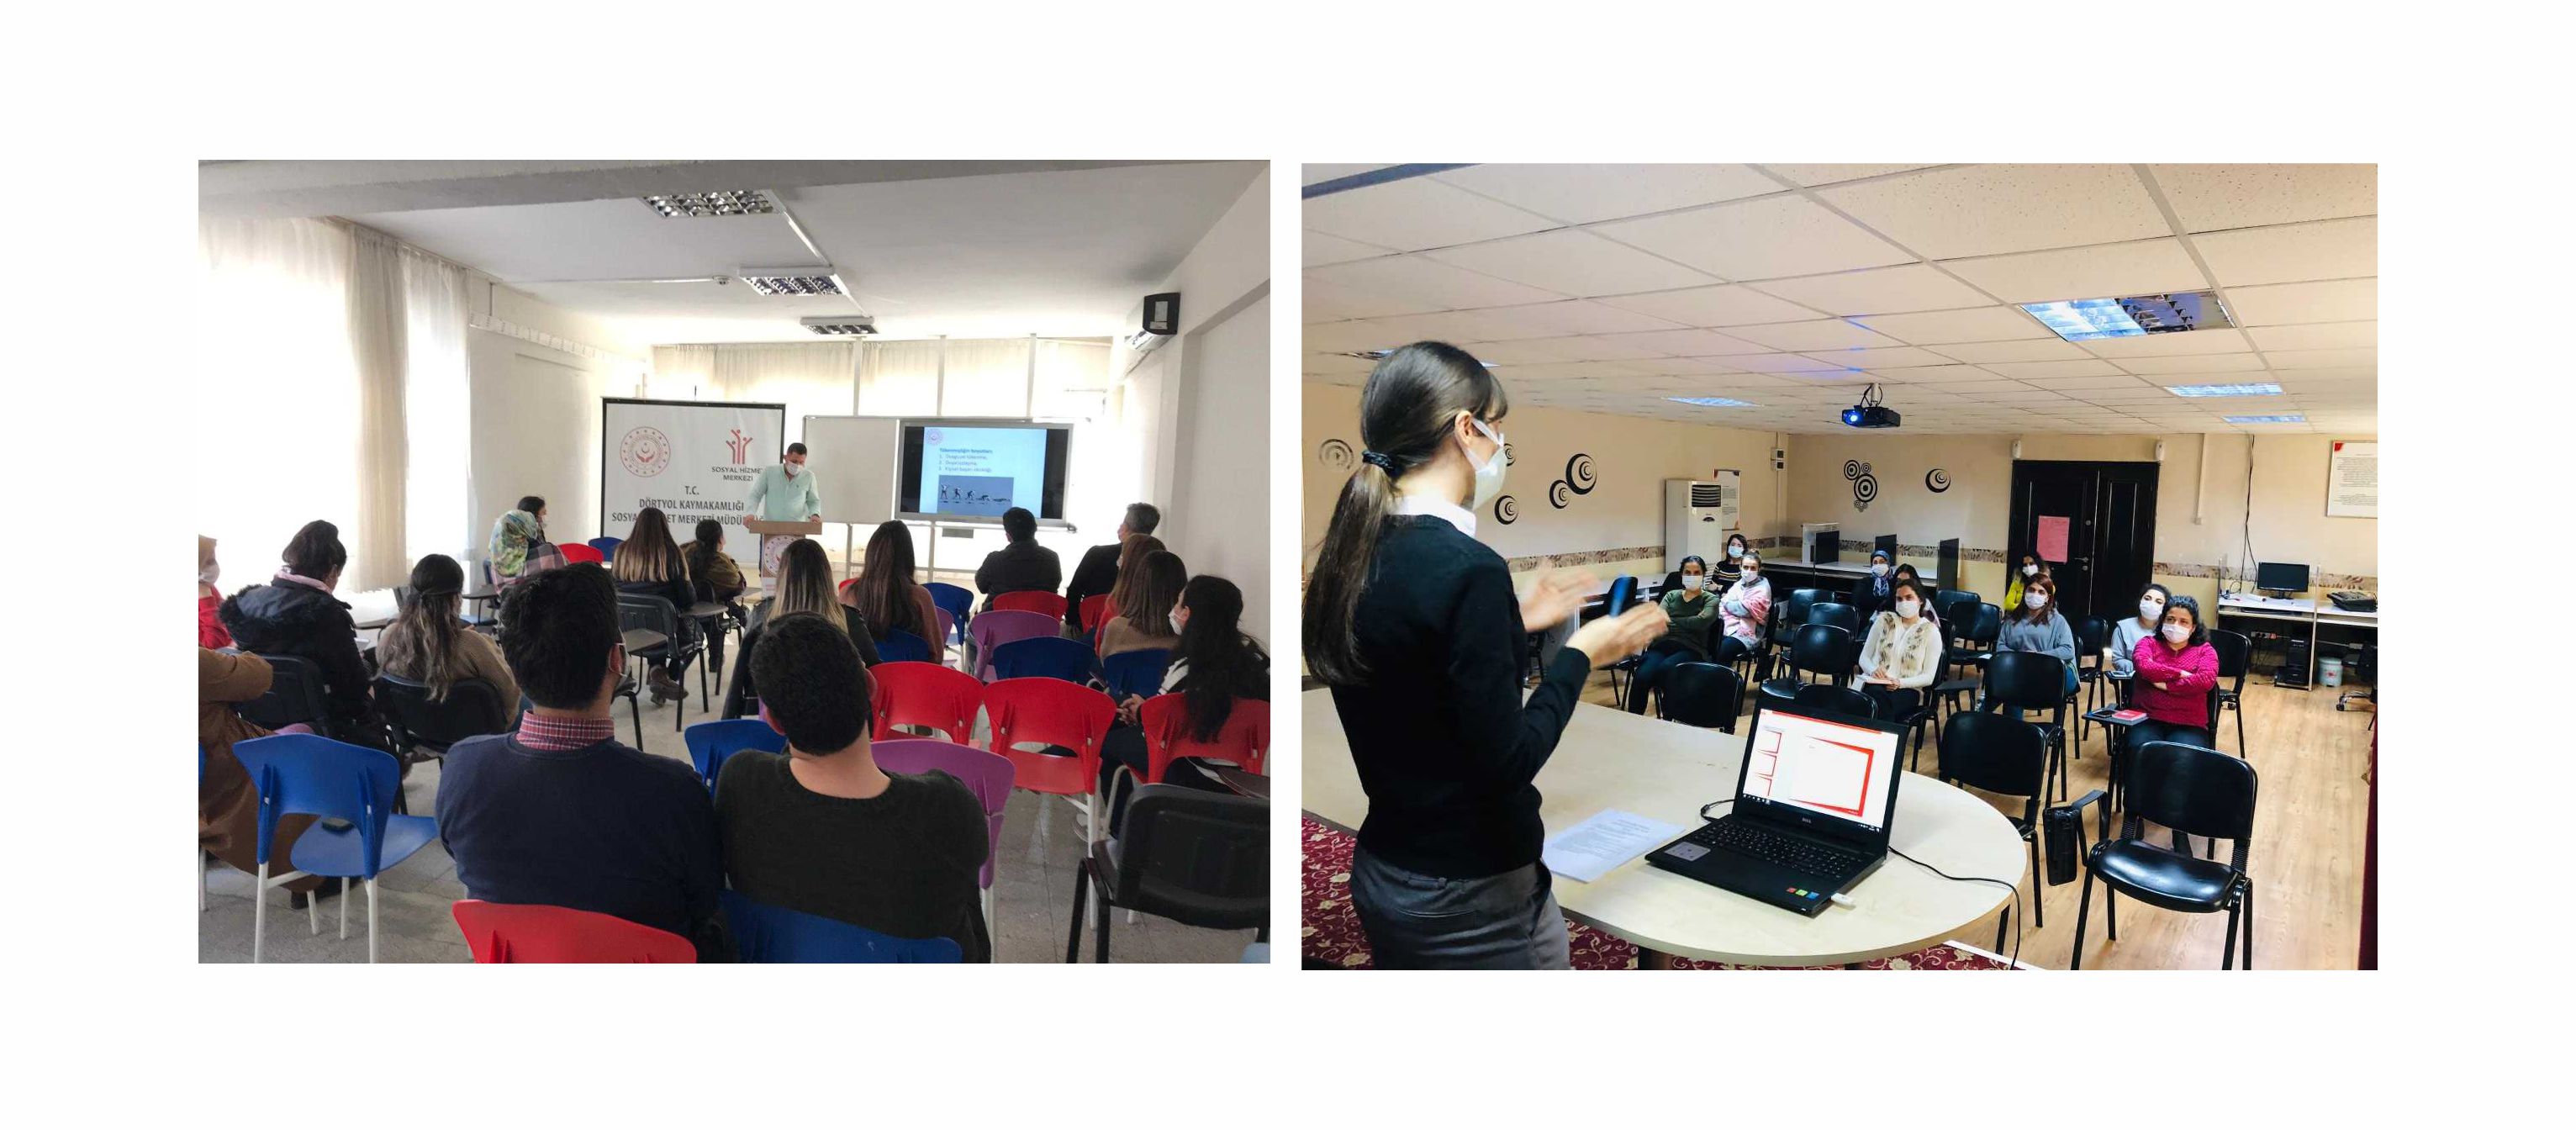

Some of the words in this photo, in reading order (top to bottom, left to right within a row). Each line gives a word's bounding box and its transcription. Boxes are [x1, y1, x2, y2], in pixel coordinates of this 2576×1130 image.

[684, 486, 699, 494] T.C.
[639, 497, 677, 509] DÖRTYOL
[679, 500, 744, 511] KAYMAKAMLIĞI
[612, 513, 638, 522] SOSYA
